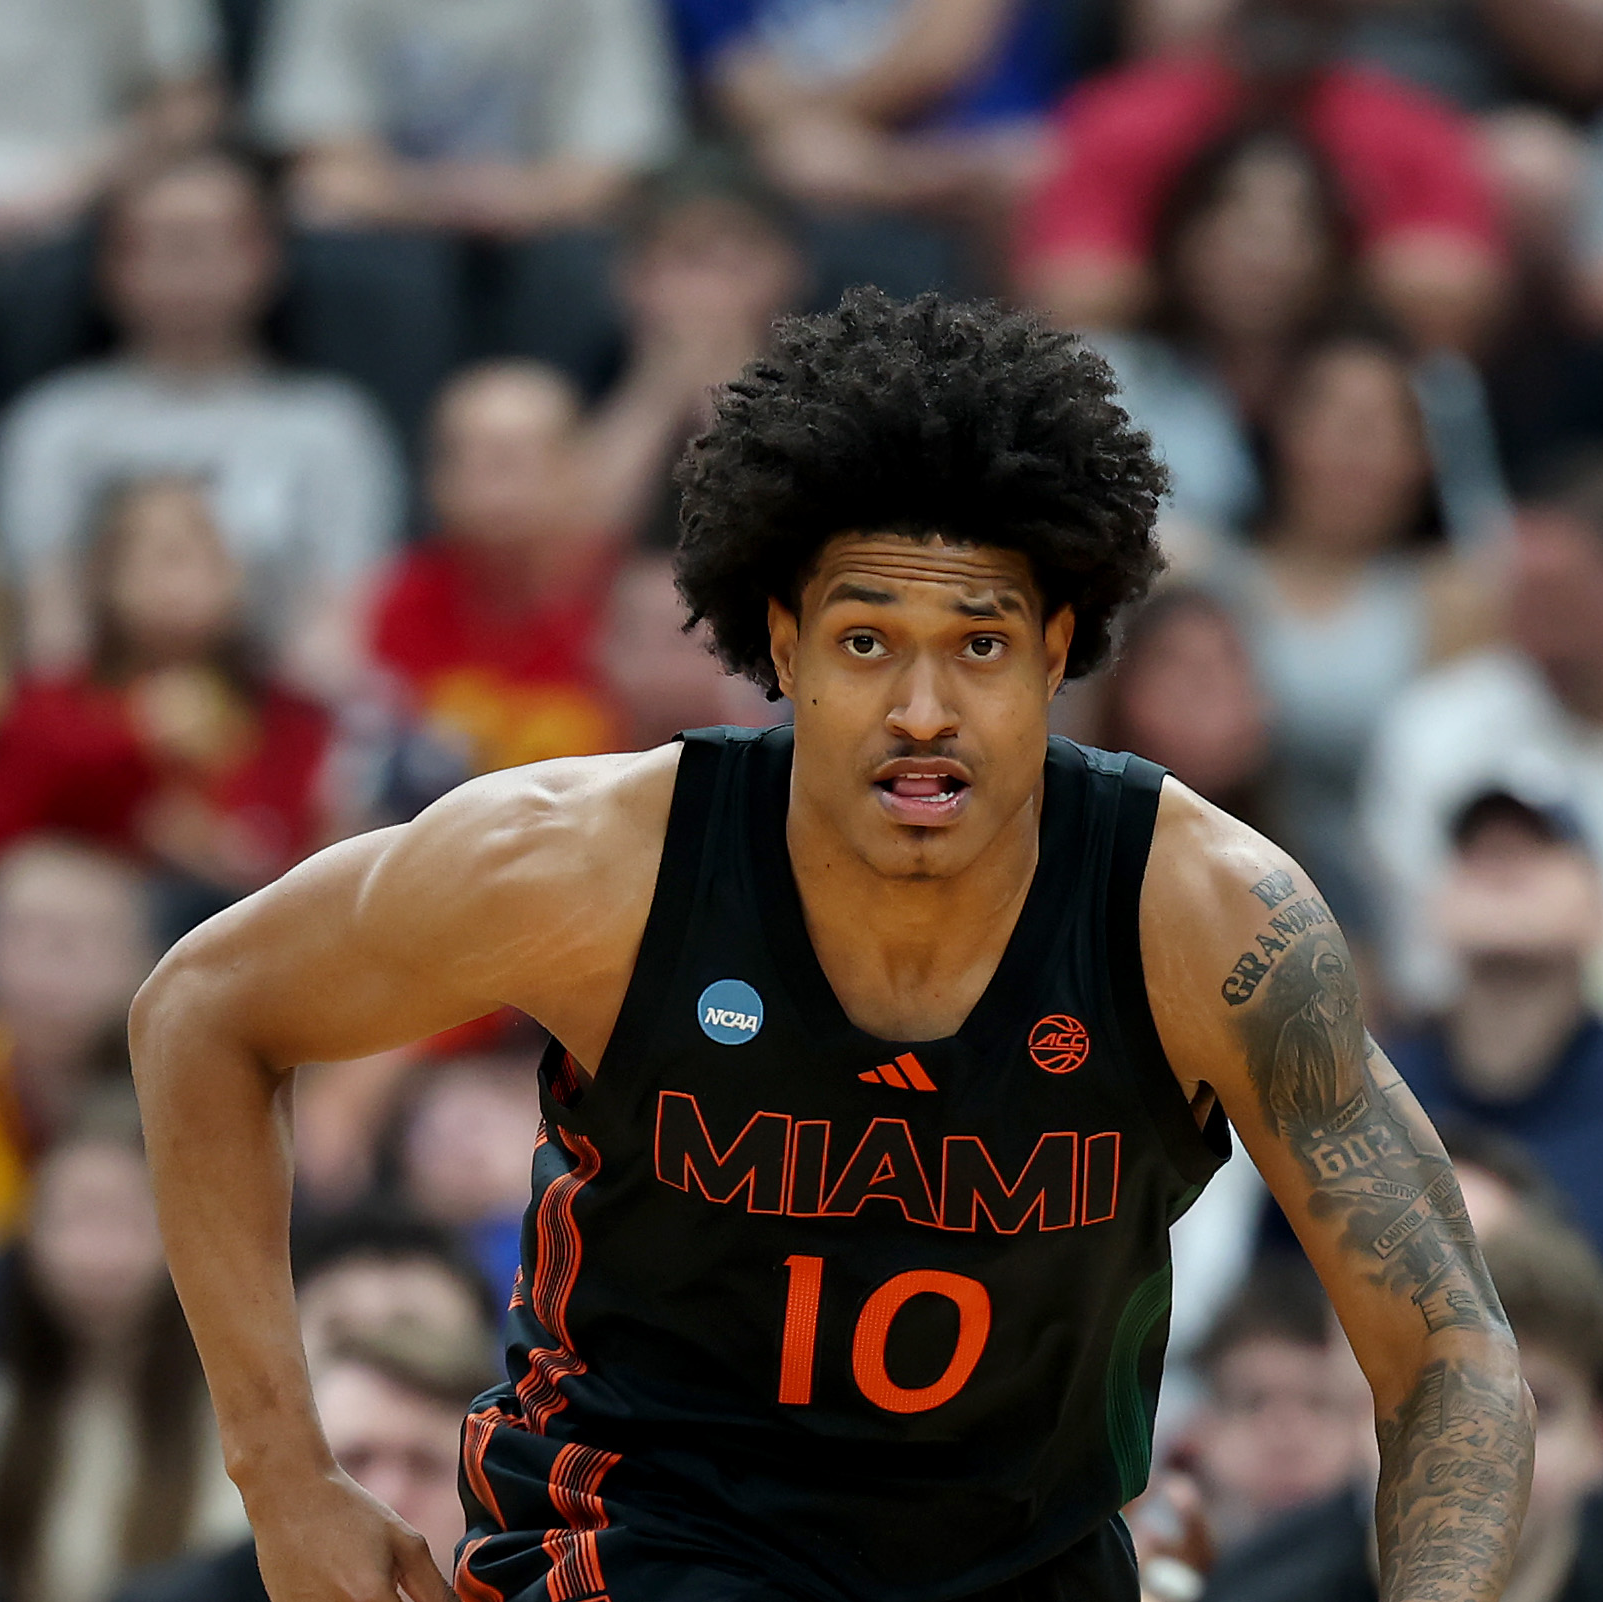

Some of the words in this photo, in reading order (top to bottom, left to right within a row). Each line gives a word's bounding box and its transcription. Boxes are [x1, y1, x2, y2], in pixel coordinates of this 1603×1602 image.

[704, 1006, 759, 1033] NCAA
[1034, 1032, 1087, 1050] ACC
[654, 1090, 1121, 1234] MIAMI
[778, 1254, 992, 1414] 10
